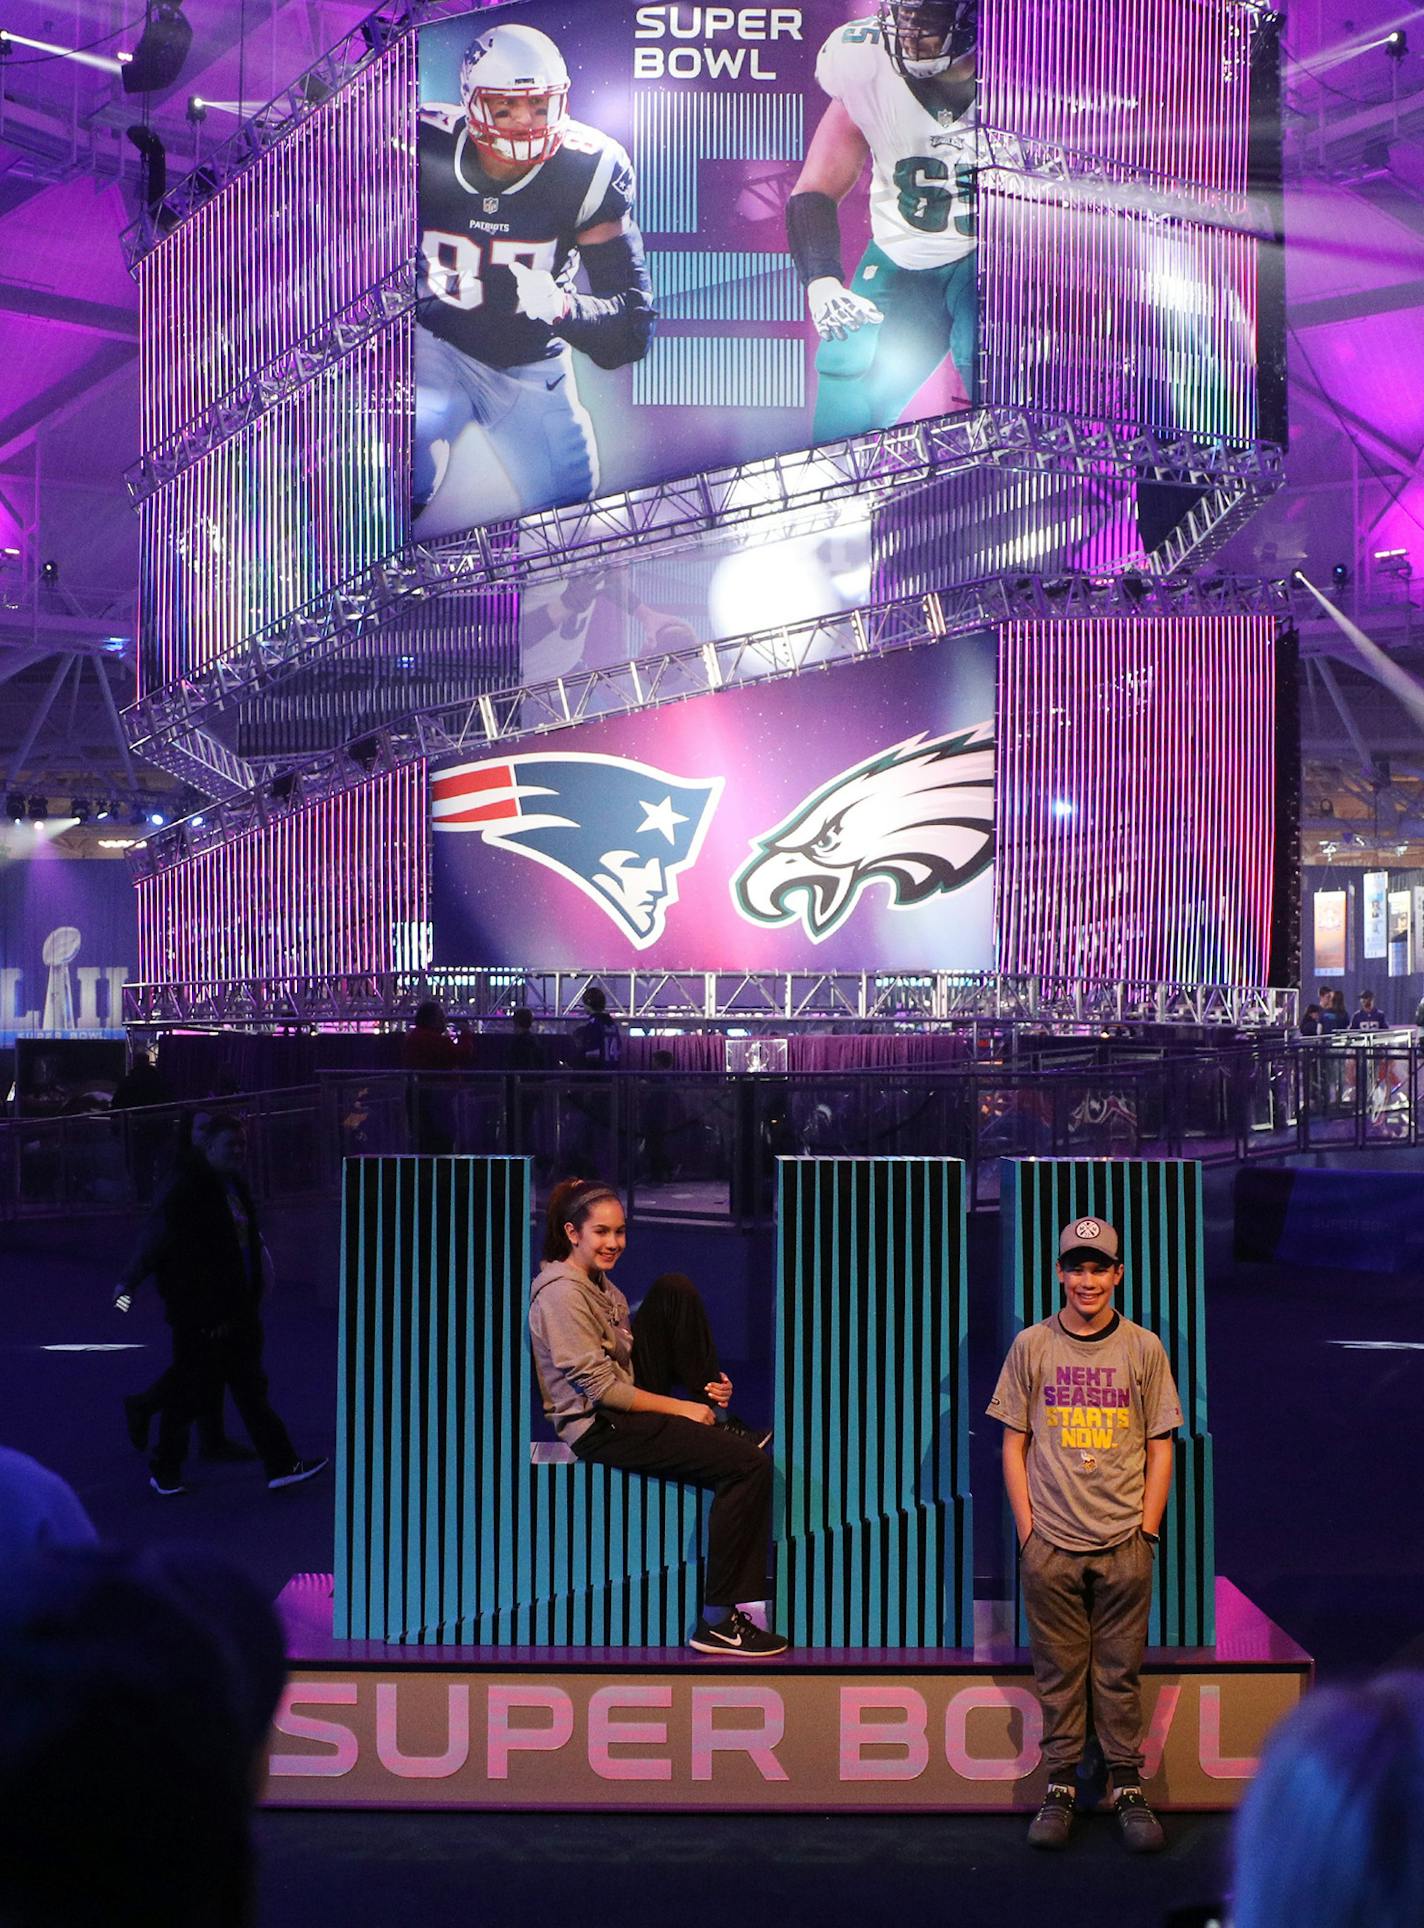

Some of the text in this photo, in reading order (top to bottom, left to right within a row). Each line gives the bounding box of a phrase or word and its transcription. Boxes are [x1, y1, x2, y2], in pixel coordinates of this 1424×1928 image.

[635, 7, 803, 40] SUPER
[634, 47, 777, 80] BOWL
[469, 219, 509, 233] PATRIOTS
[1044, 1386, 1130, 1408] SEASON
[1045, 1407, 1130, 1429] STARTS
[268, 1683, 1259, 1781] SUPER BOL
